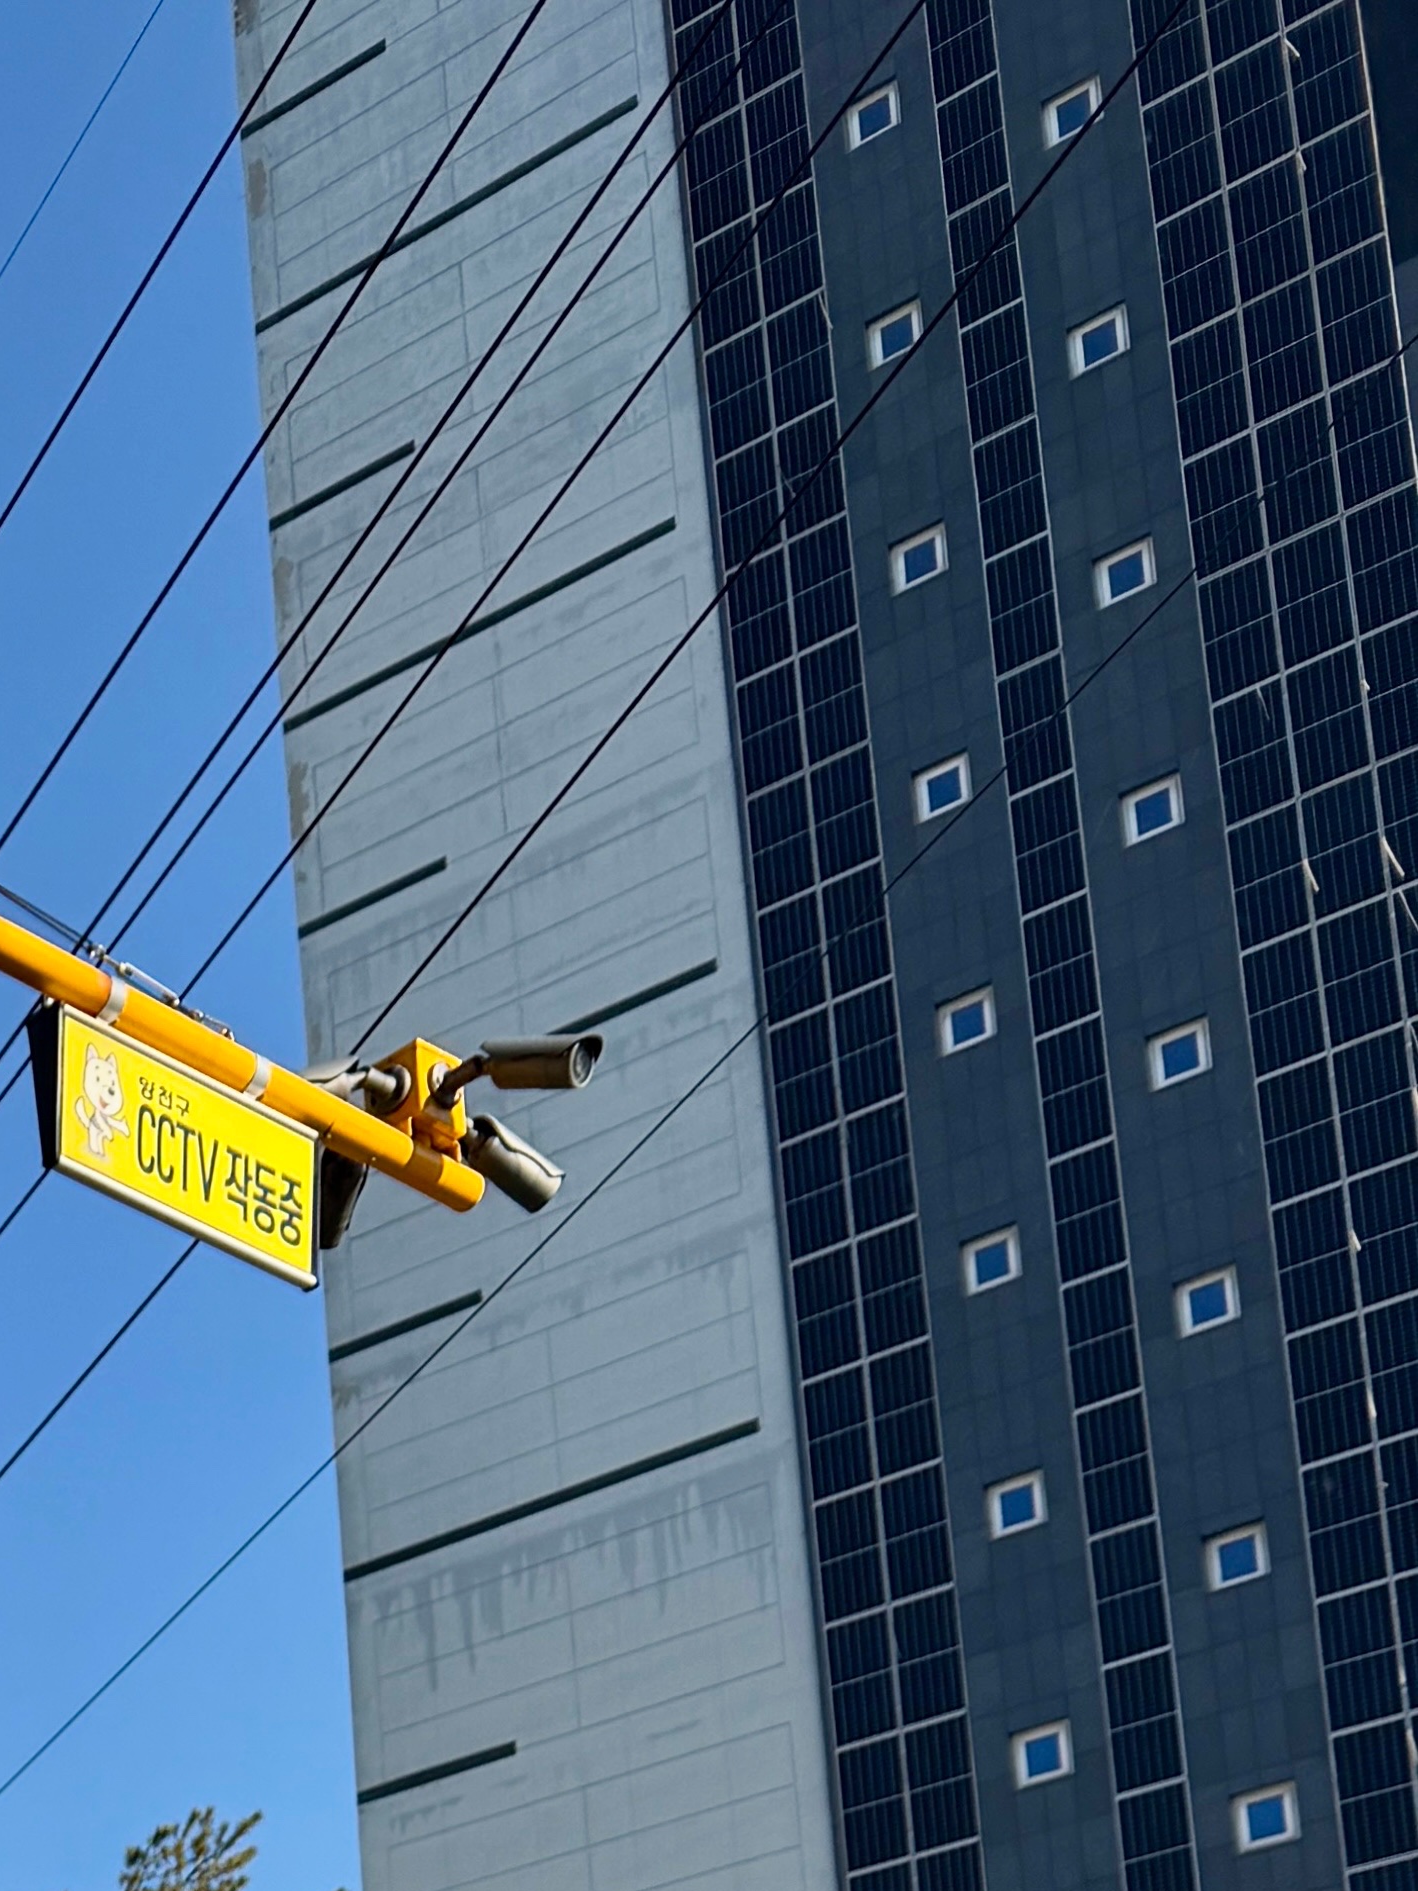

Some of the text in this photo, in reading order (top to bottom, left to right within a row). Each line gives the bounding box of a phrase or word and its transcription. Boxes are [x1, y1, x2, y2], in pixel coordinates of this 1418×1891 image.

[138, 1076, 192, 1117] 양천구
[136, 1104, 304, 1248] CCTV 작동중
